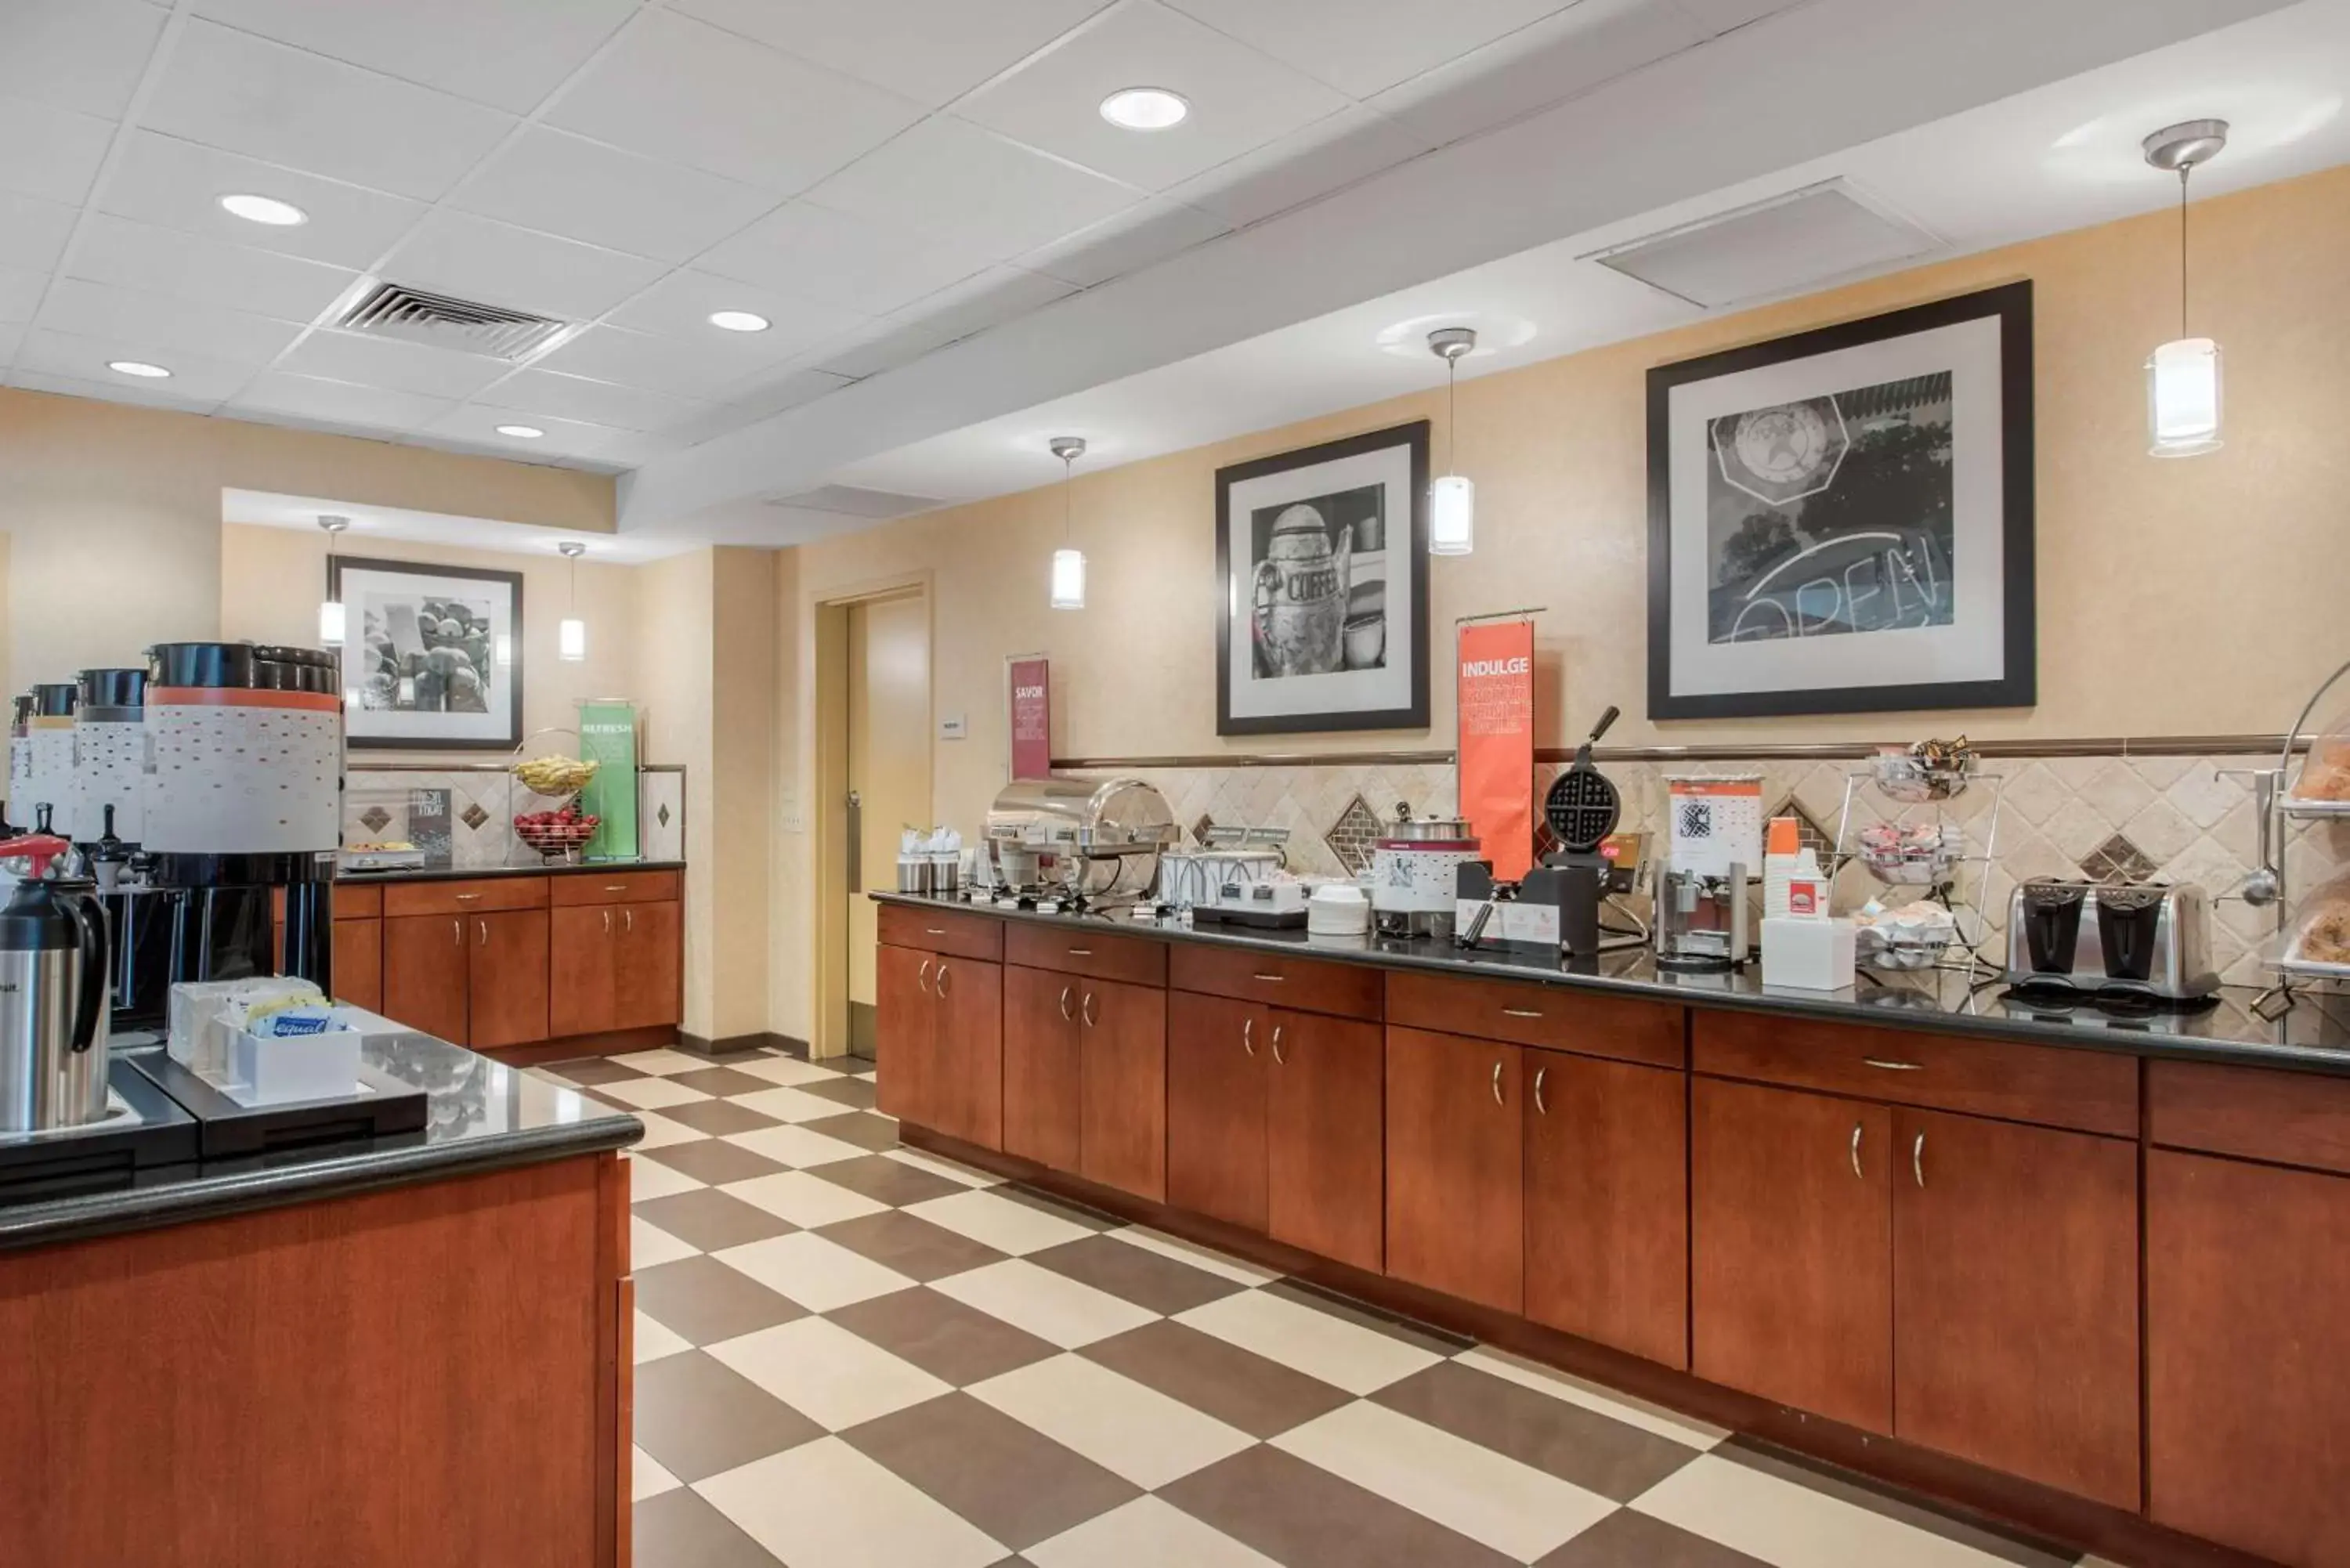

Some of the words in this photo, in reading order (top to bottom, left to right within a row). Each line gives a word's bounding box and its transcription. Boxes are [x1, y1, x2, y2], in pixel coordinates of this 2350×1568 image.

[1462, 656, 1528, 677] INDULGE
[1016, 686, 1043, 699] SAVOR
[277, 1021, 324, 1039] equal
